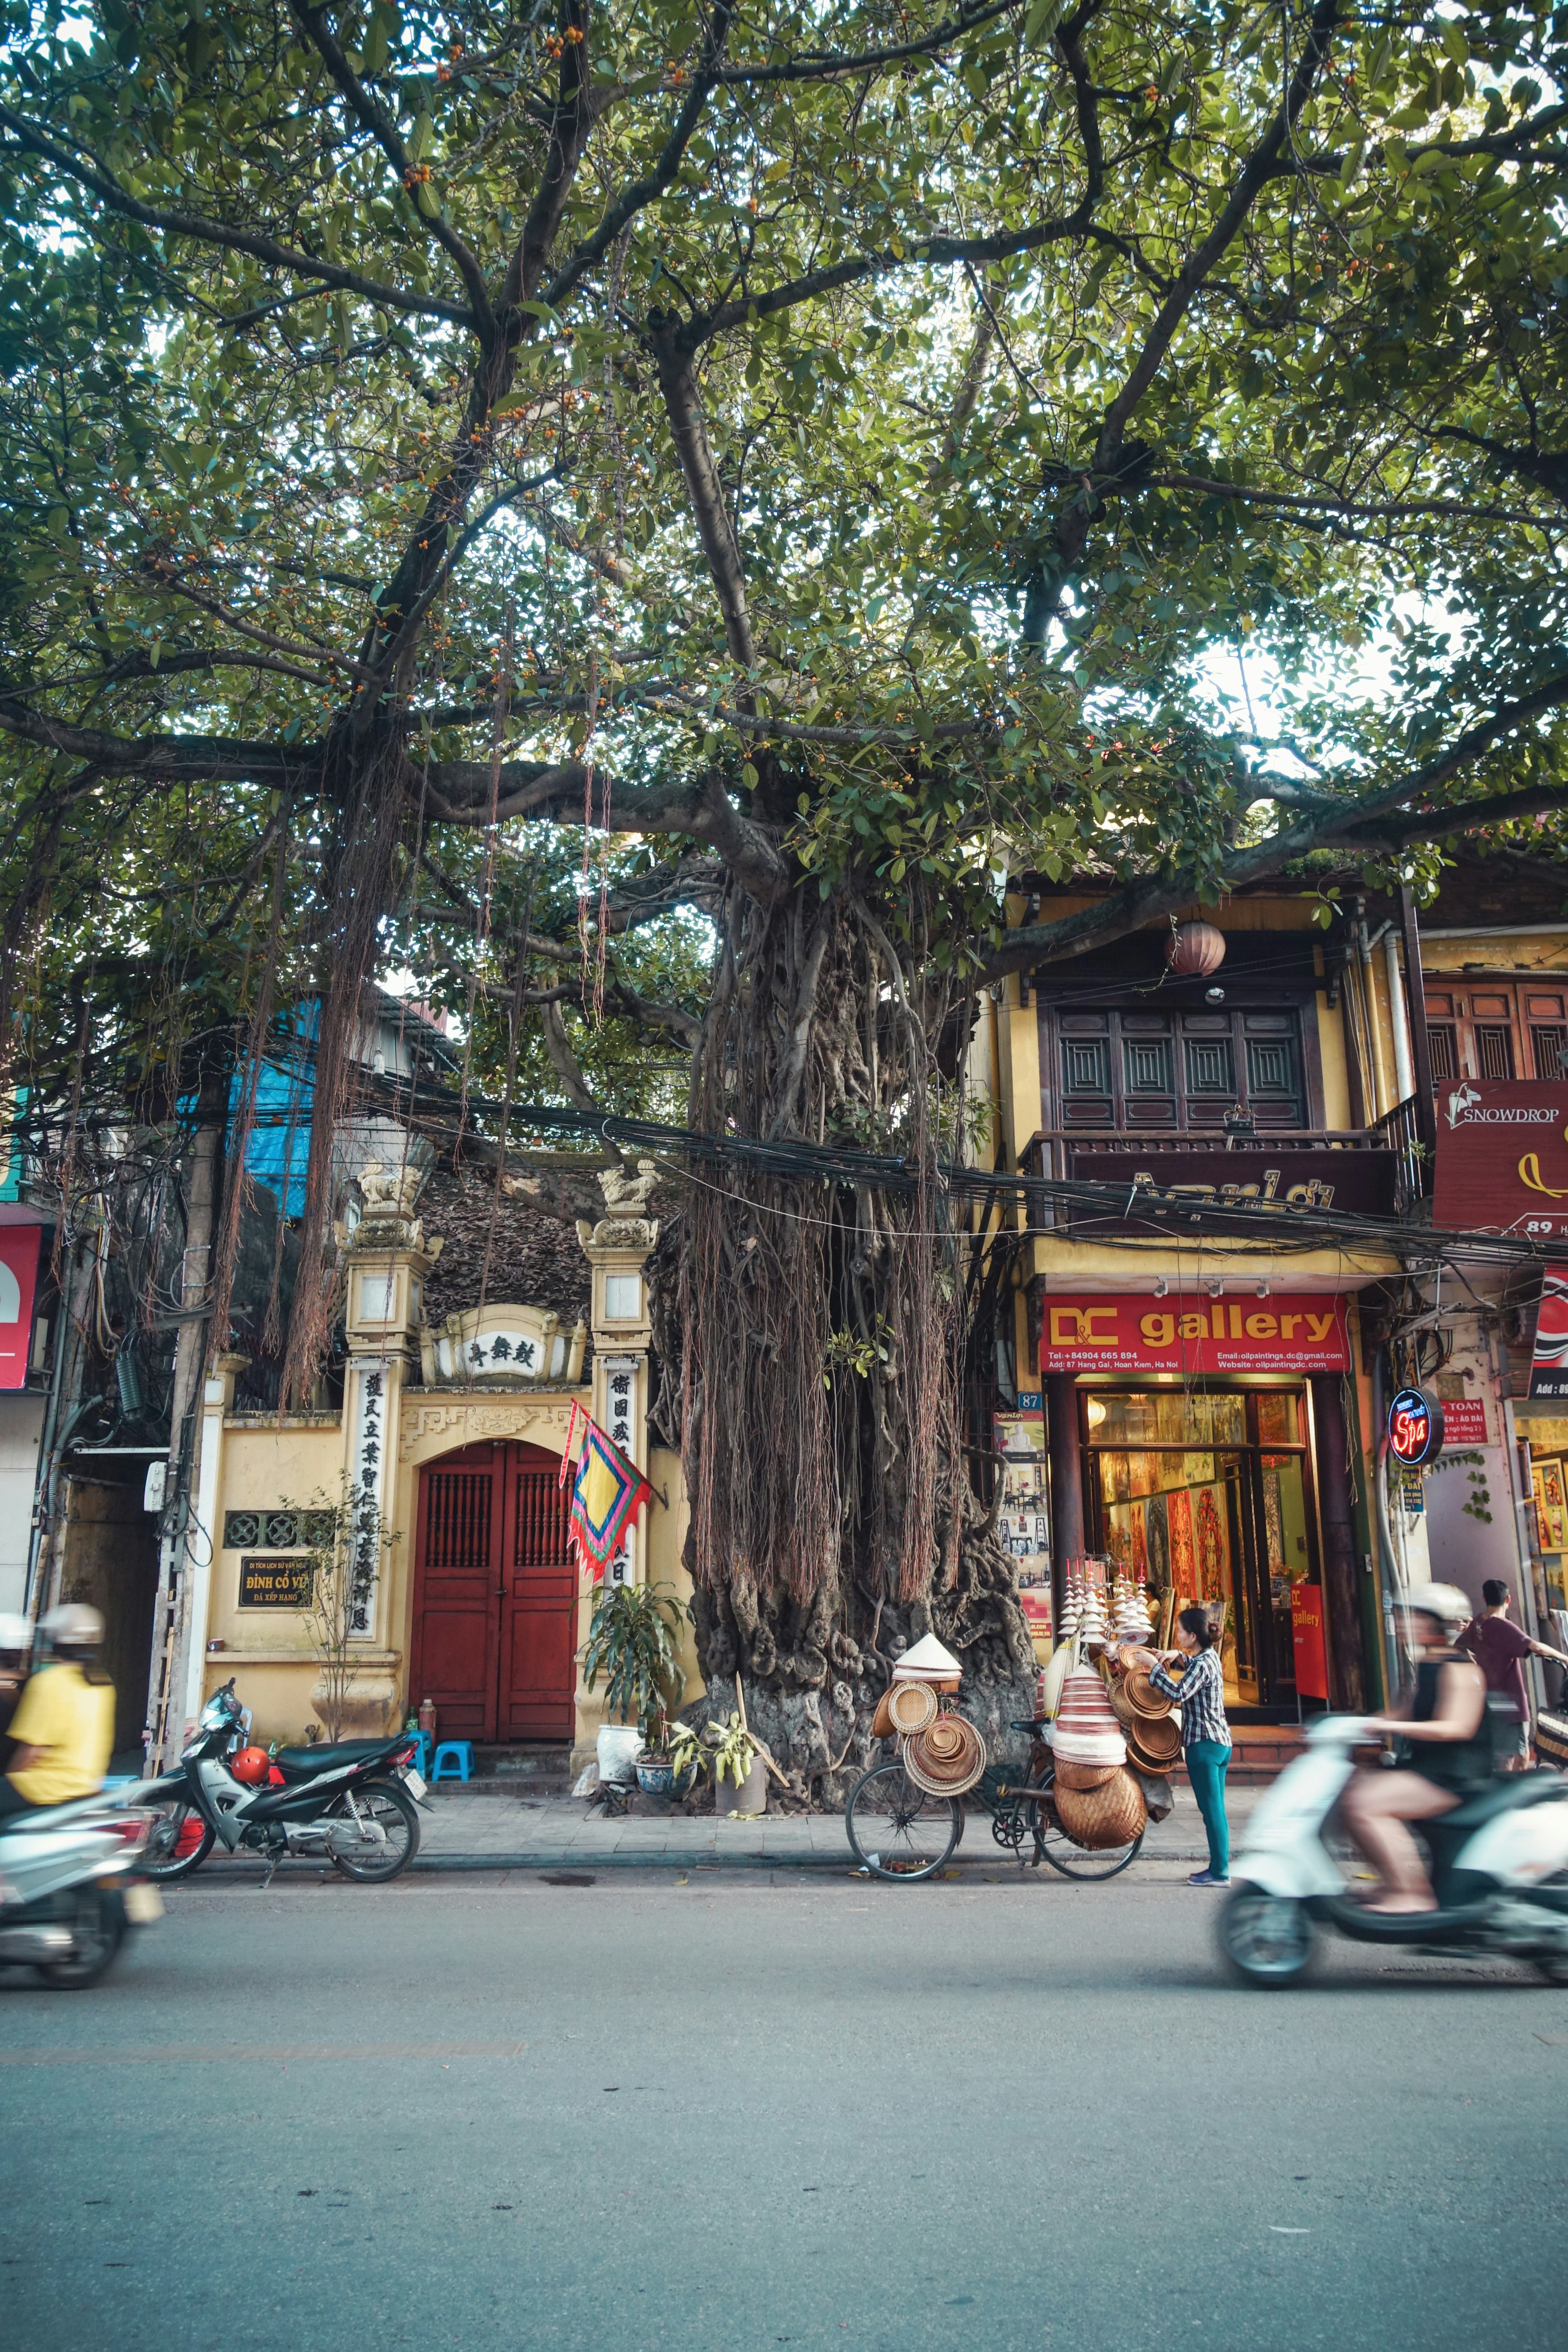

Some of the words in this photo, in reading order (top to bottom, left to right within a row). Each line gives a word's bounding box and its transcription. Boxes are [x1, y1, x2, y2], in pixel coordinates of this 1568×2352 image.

[1464, 1109, 1559, 1121] SNOWDROP
[1527, 1221, 1552, 1233] 89
[1140, 1305, 1335, 1347] gallery
[1559, 1384, 1568, 1394] 89
[1023, 1395, 1037, 1407] 87
[1449, 1401, 1480, 1410] TOÀN
[1393, 1413, 1425, 1455] Spa
[246, 1573, 273, 1589] ĐÌNH
[275, 1570, 289, 1589] CỔ
[279, 1593, 297, 1602] HẠNG
[1293, 1610, 1319, 1627] gallery
